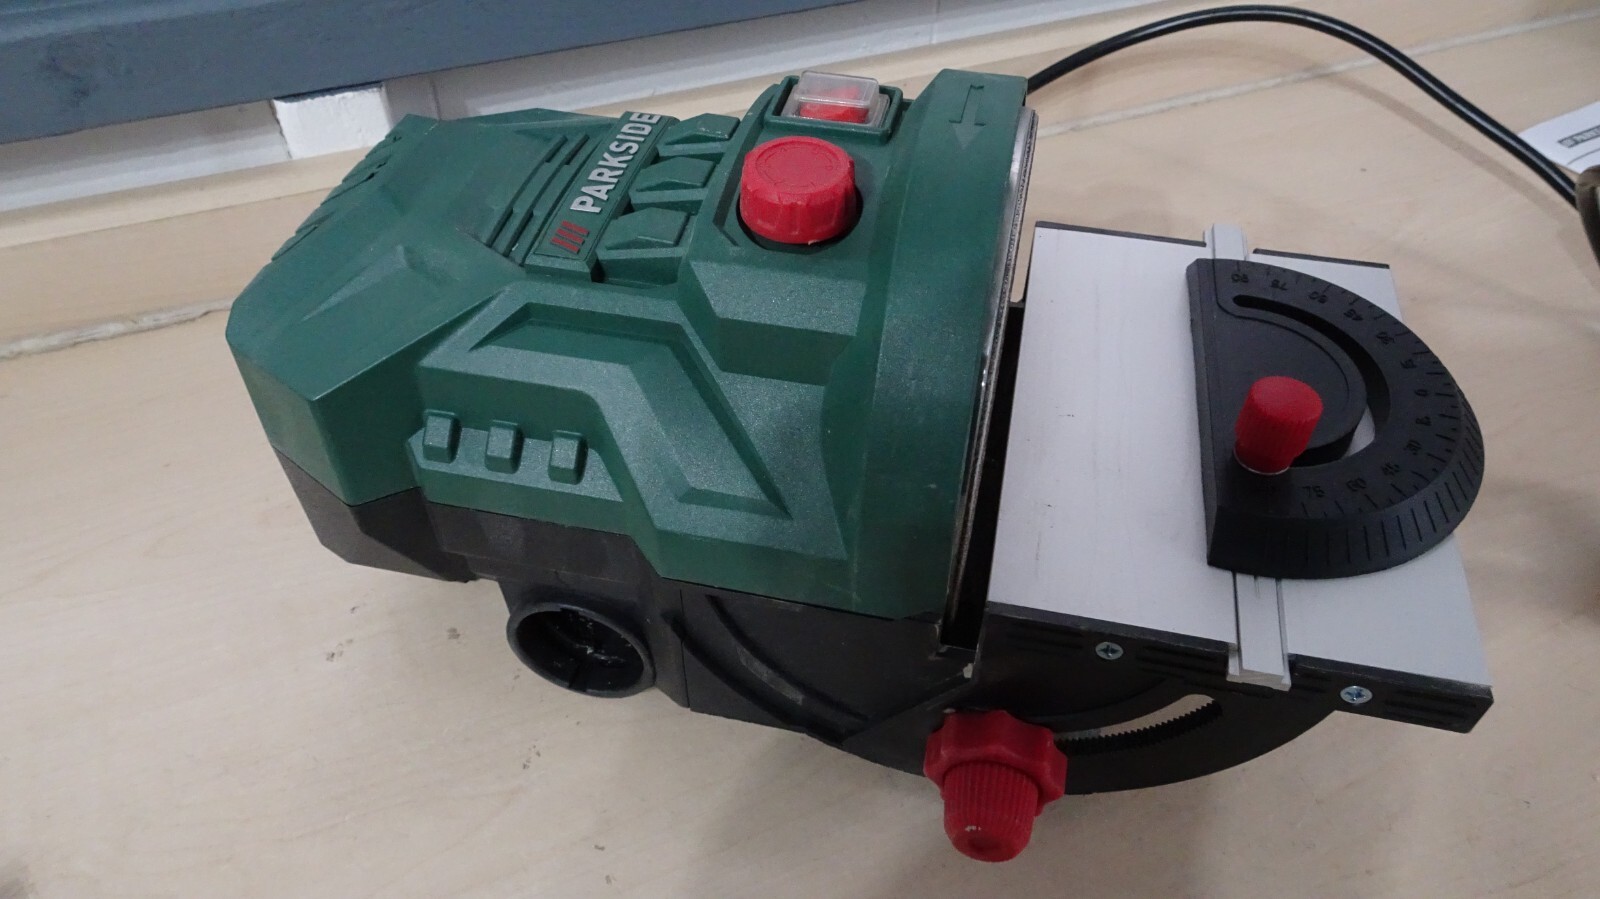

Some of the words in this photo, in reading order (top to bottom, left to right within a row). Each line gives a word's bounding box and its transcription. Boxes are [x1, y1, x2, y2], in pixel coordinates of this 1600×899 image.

[570, 112, 662, 213] PARKSIDE
[1415, 389, 1429, 397] 0
[1302, 485, 1326, 498] 75
